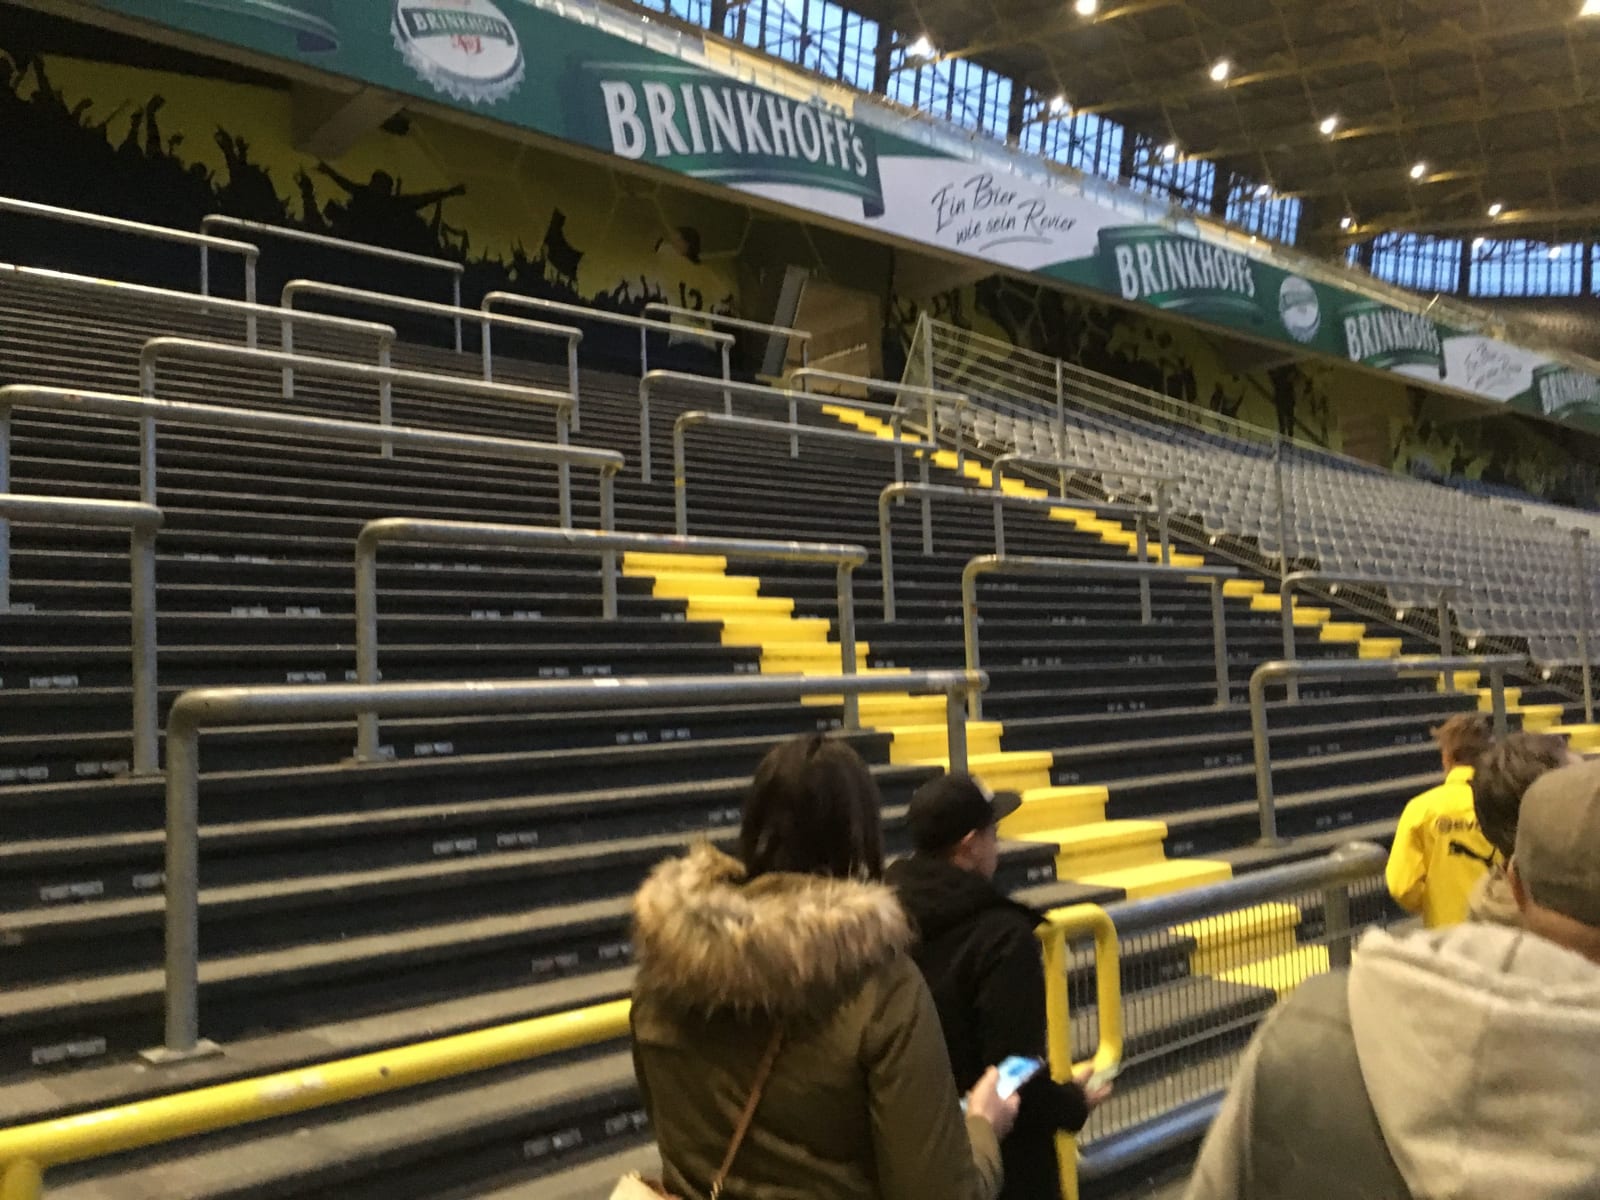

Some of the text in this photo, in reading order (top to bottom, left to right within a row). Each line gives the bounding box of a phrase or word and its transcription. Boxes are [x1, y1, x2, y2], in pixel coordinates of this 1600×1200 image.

[601, 80, 868, 178] BRINKHOFF's
[931, 172, 1017, 234] Ein Bier
[956, 198, 1077, 245] wie sein Revier
